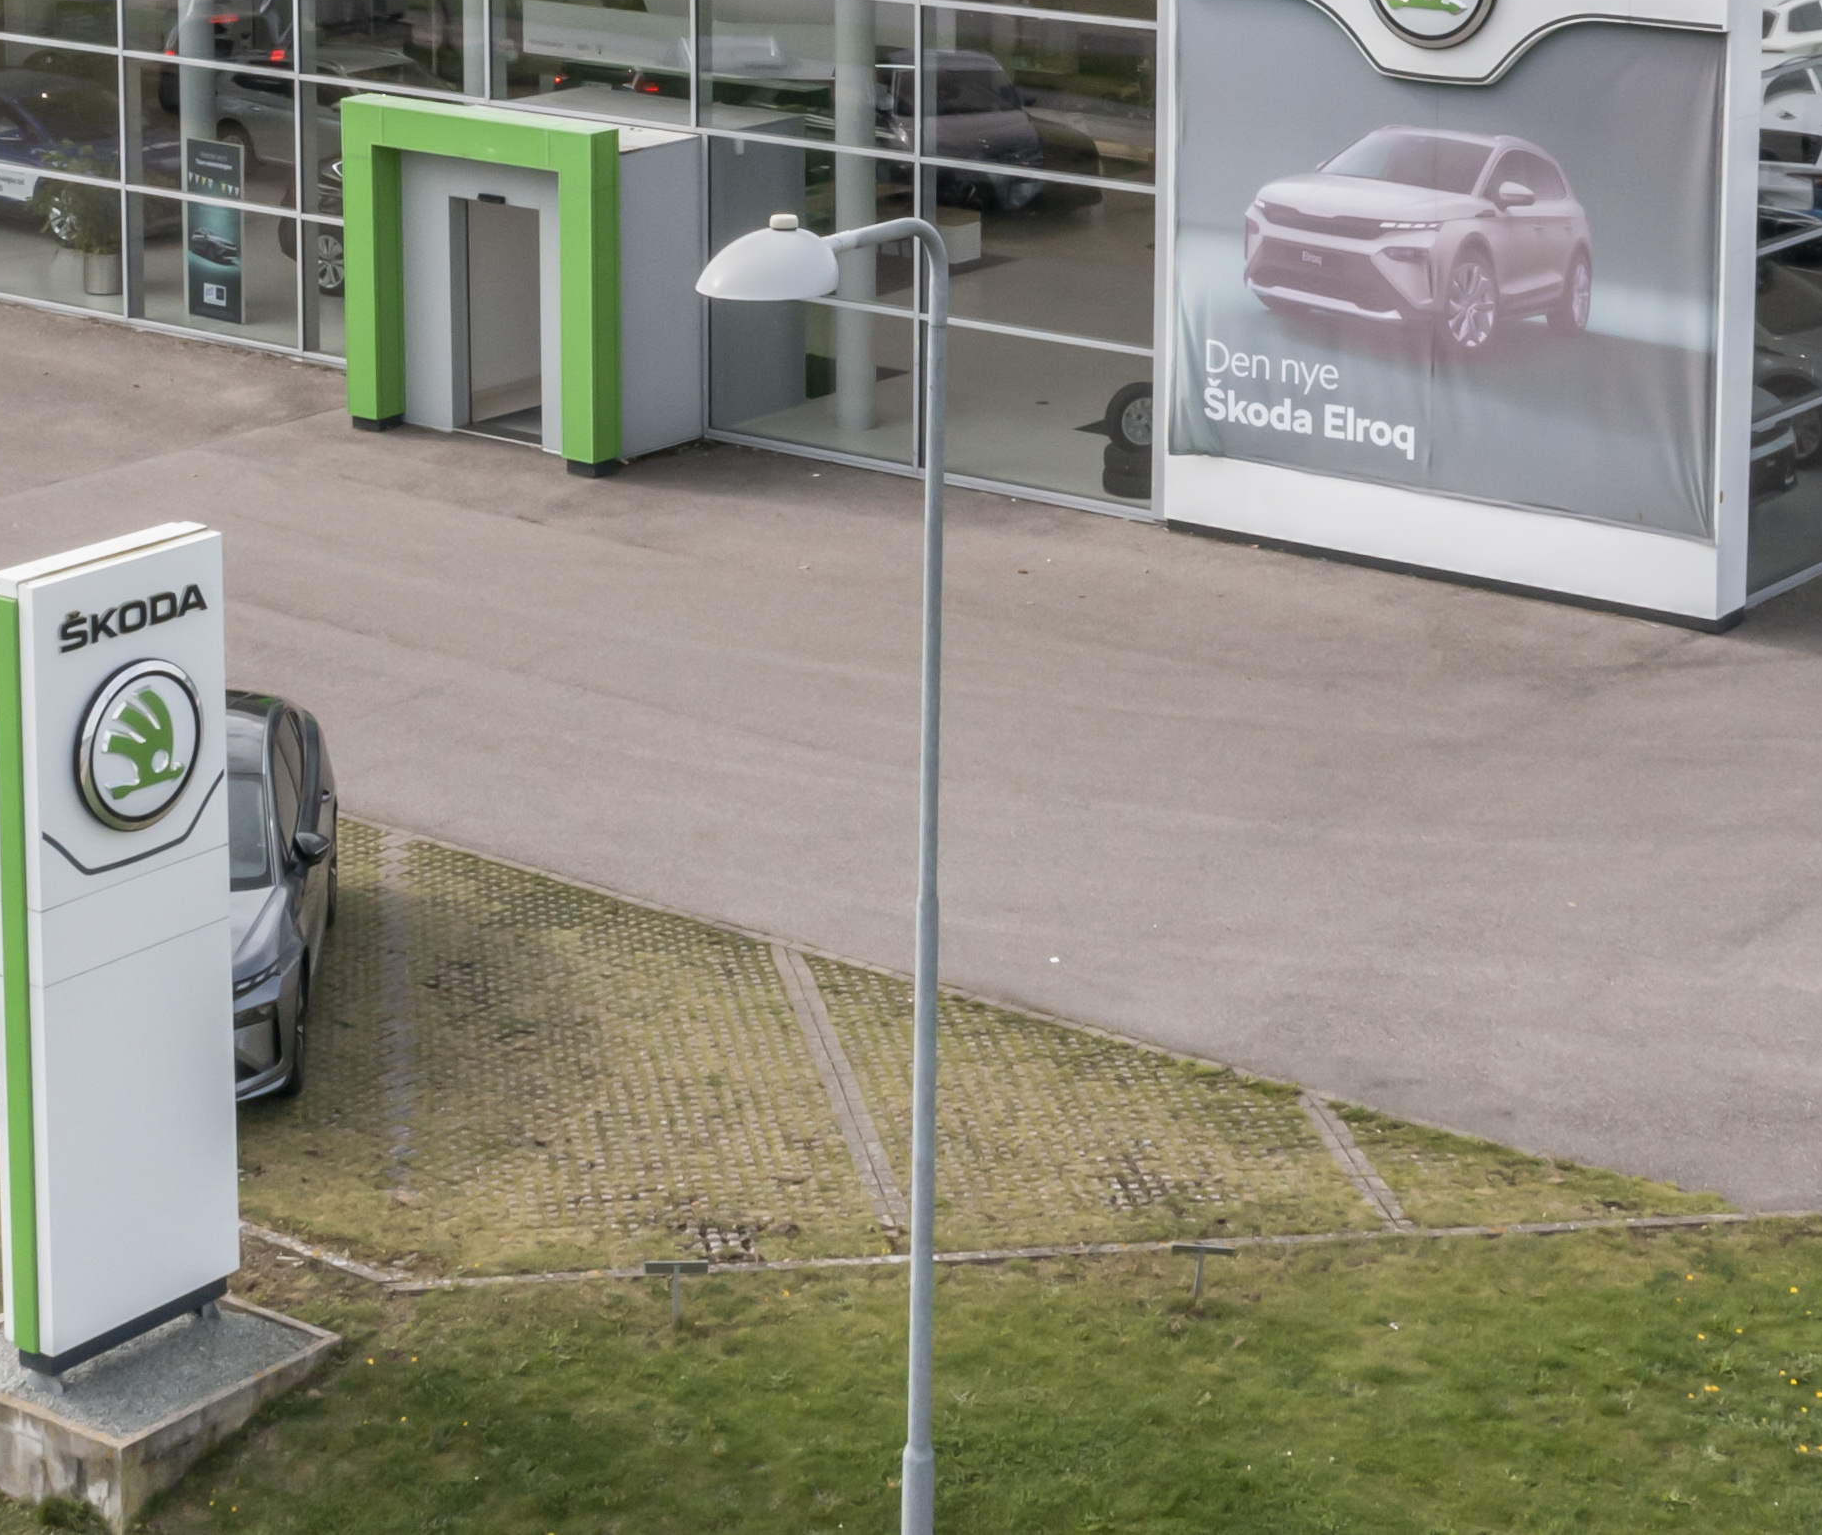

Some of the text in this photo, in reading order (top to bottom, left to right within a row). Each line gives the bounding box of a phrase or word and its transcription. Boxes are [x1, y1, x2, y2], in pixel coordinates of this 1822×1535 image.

[1302, 249, 1323, 266] Elroq
[1206, 339, 1339, 395] Den nye
[1204, 377, 1415, 461] Škoda Elroq
[58, 583, 208, 653] ŠKODA
